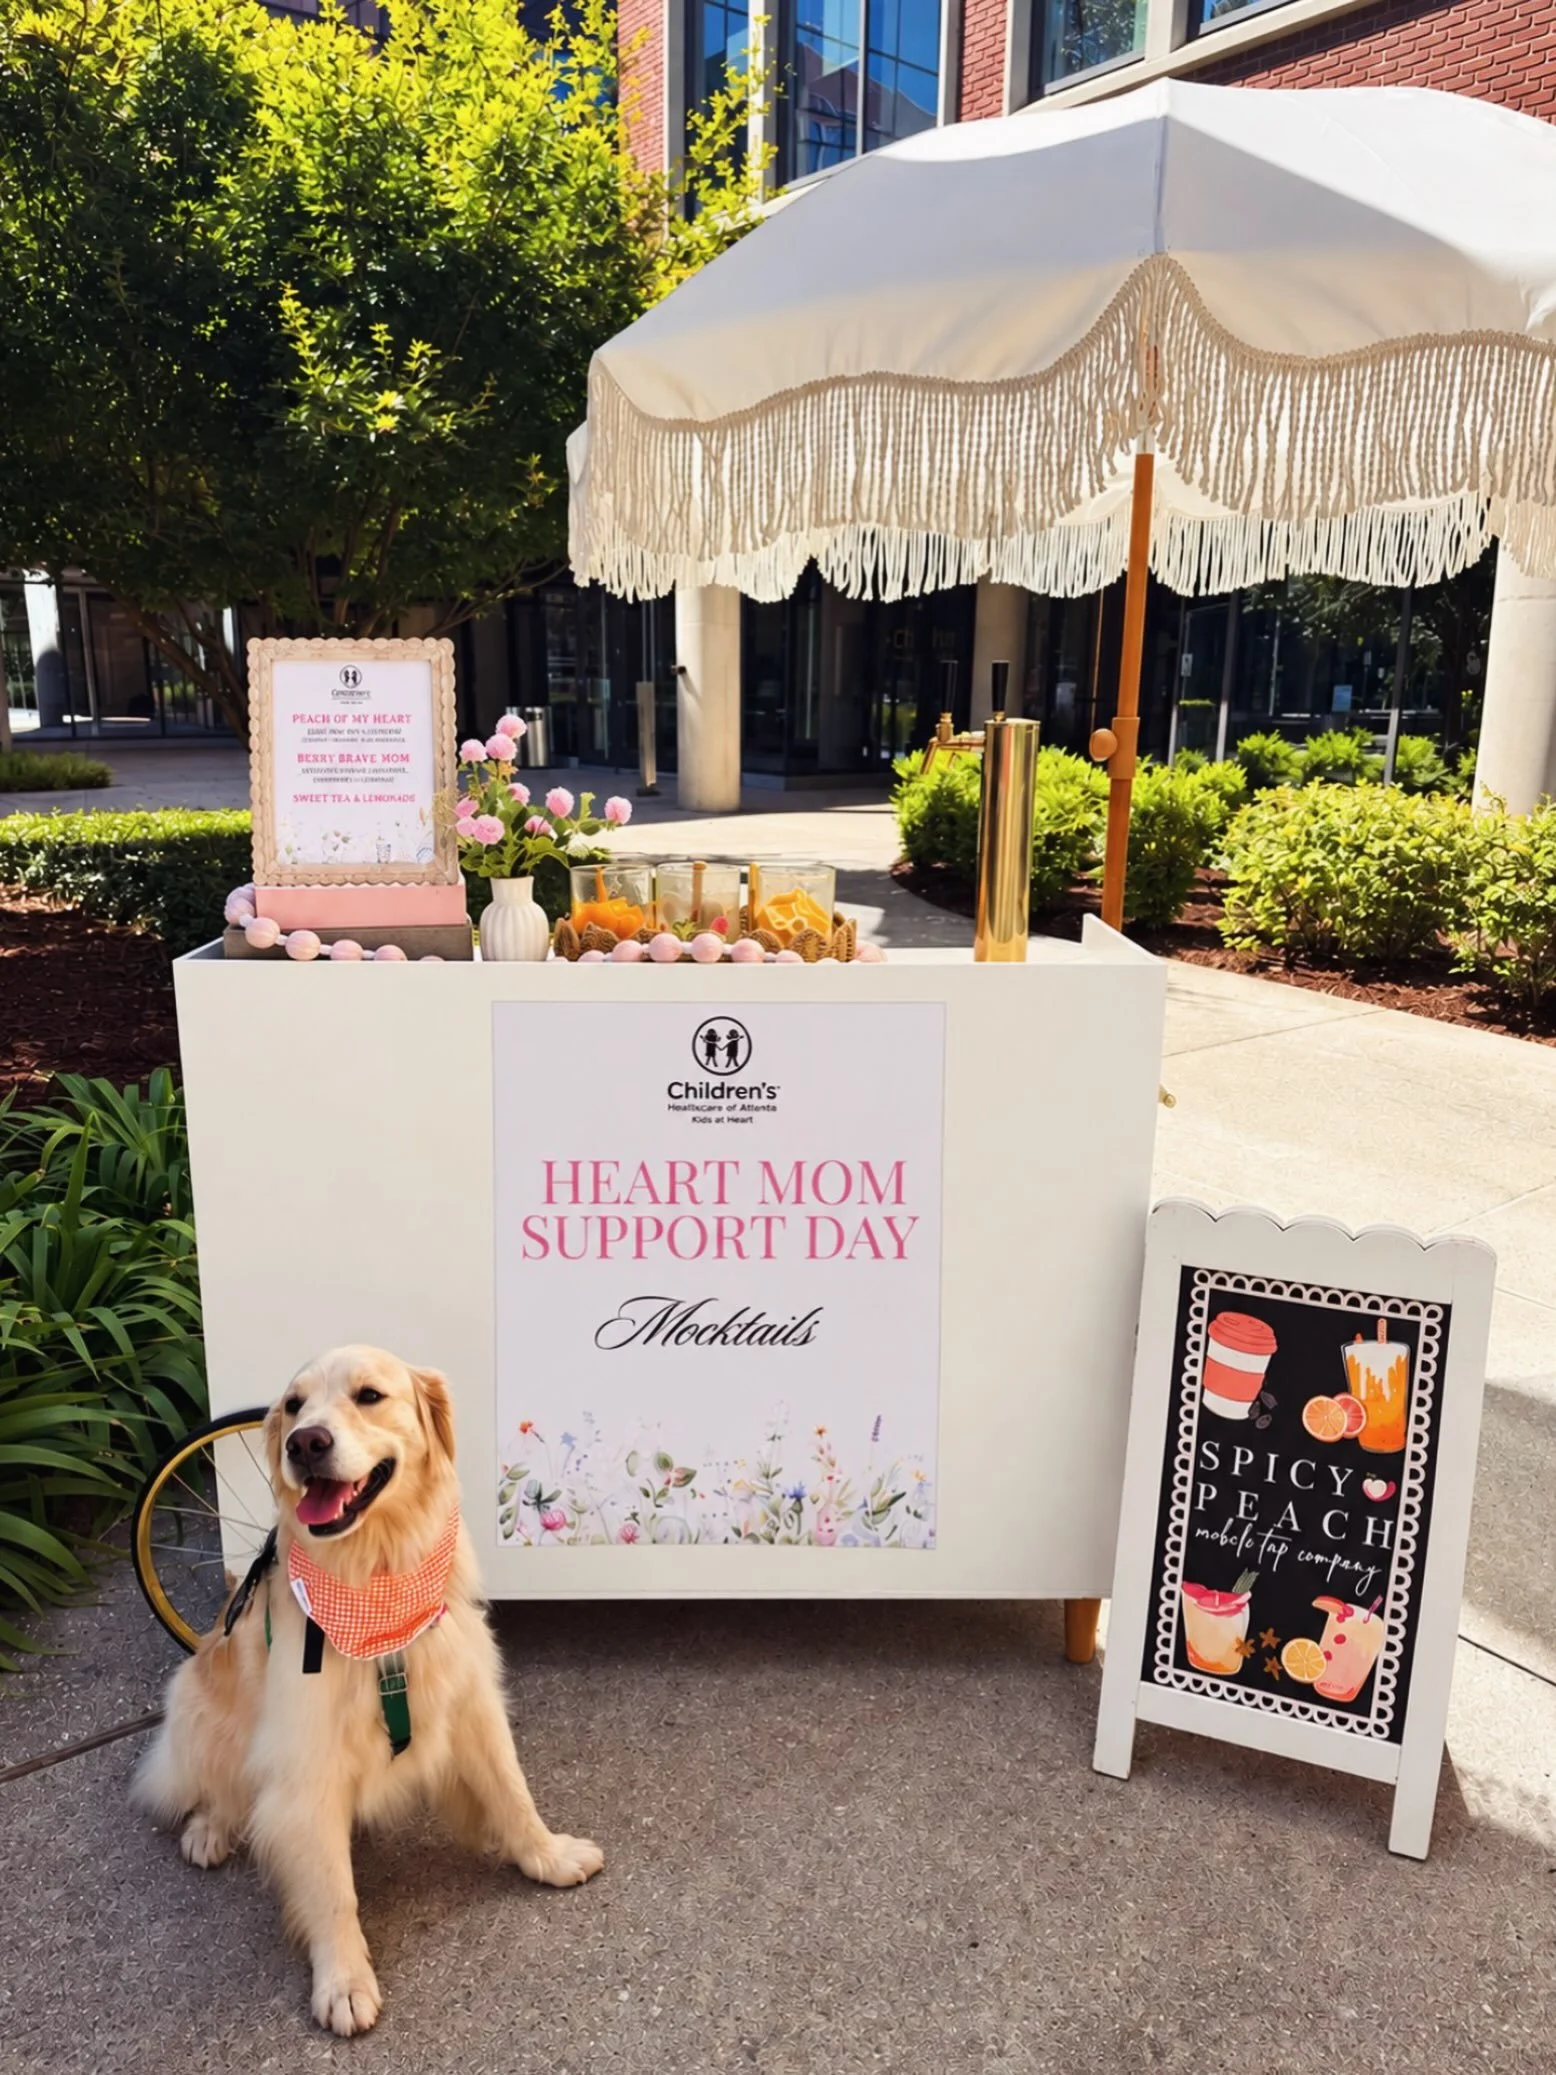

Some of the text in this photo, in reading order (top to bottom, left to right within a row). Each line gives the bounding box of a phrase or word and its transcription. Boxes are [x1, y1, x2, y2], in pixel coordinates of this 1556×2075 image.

[292, 714, 330, 724] PEACH
[351, 714, 369, 724] MY
[332, 794, 351, 803] TEA
[667, 1081, 778, 1100] Children's
[726, 1104, 737, 1112] of
[541, 1160, 907, 1206] HEART MOM
[521, 1215, 920, 1260] SUPPORT DAY
[594, 1295, 824, 1350] Mocktails
[1200, 1439, 1354, 1498] SPICY
[1195, 1482, 1396, 1550] PEACH
[1257, 1528, 1293, 1572] tap
